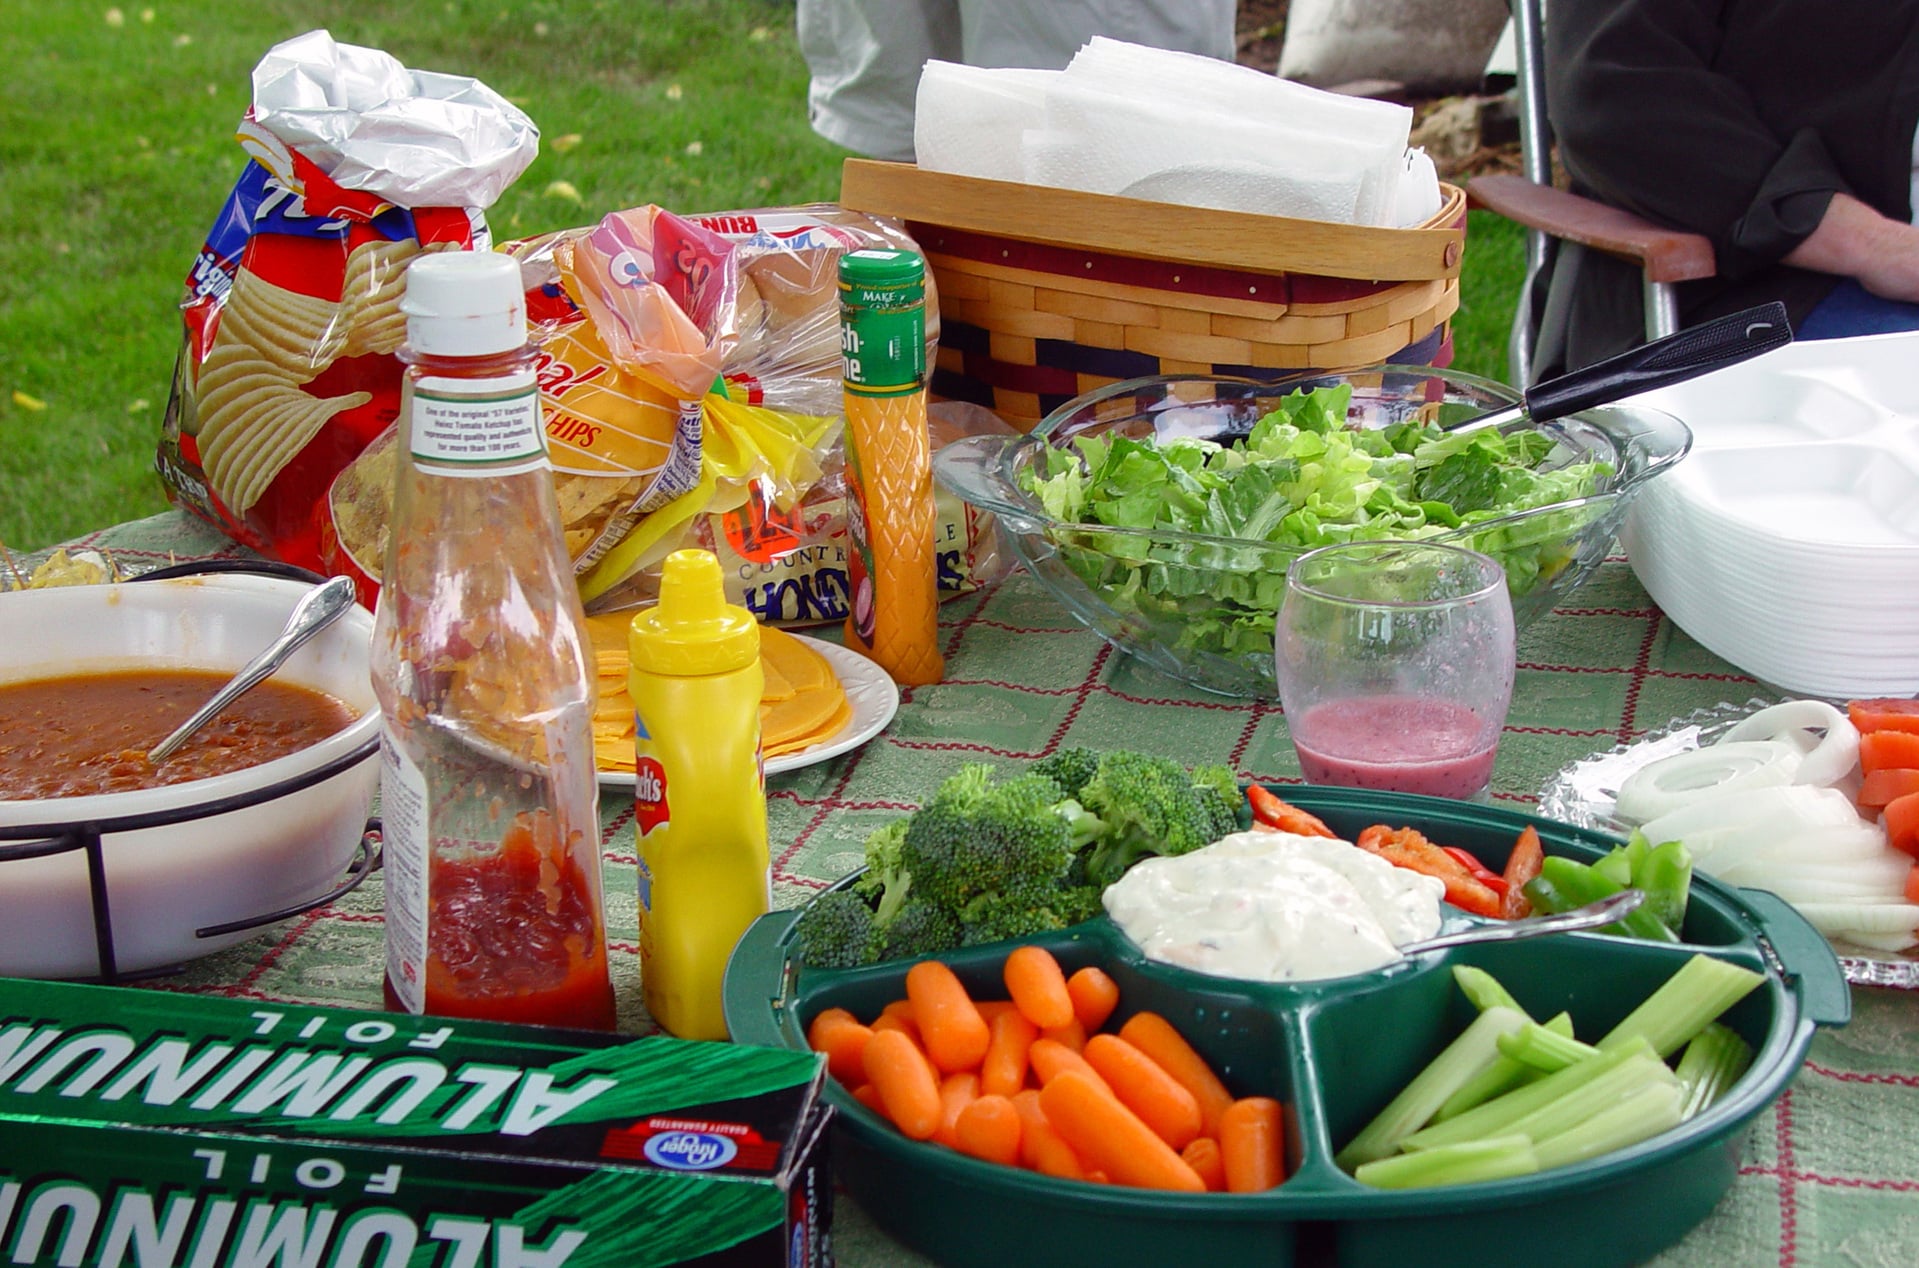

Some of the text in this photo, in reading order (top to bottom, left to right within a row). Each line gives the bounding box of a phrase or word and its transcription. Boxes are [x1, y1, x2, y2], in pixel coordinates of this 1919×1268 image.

[862, 291, 895, 302] MAKE
[739, 545, 846, 580] COUNTR
[251, 1010, 454, 1049] FOIL
[649, 1119, 749, 1136] QUALITY GUARANTEED
[659, 1135, 719, 1165] Kroger
[193, 1148, 402, 1194] FOIL
[0, 1182, 589, 1268] ALUMINU
